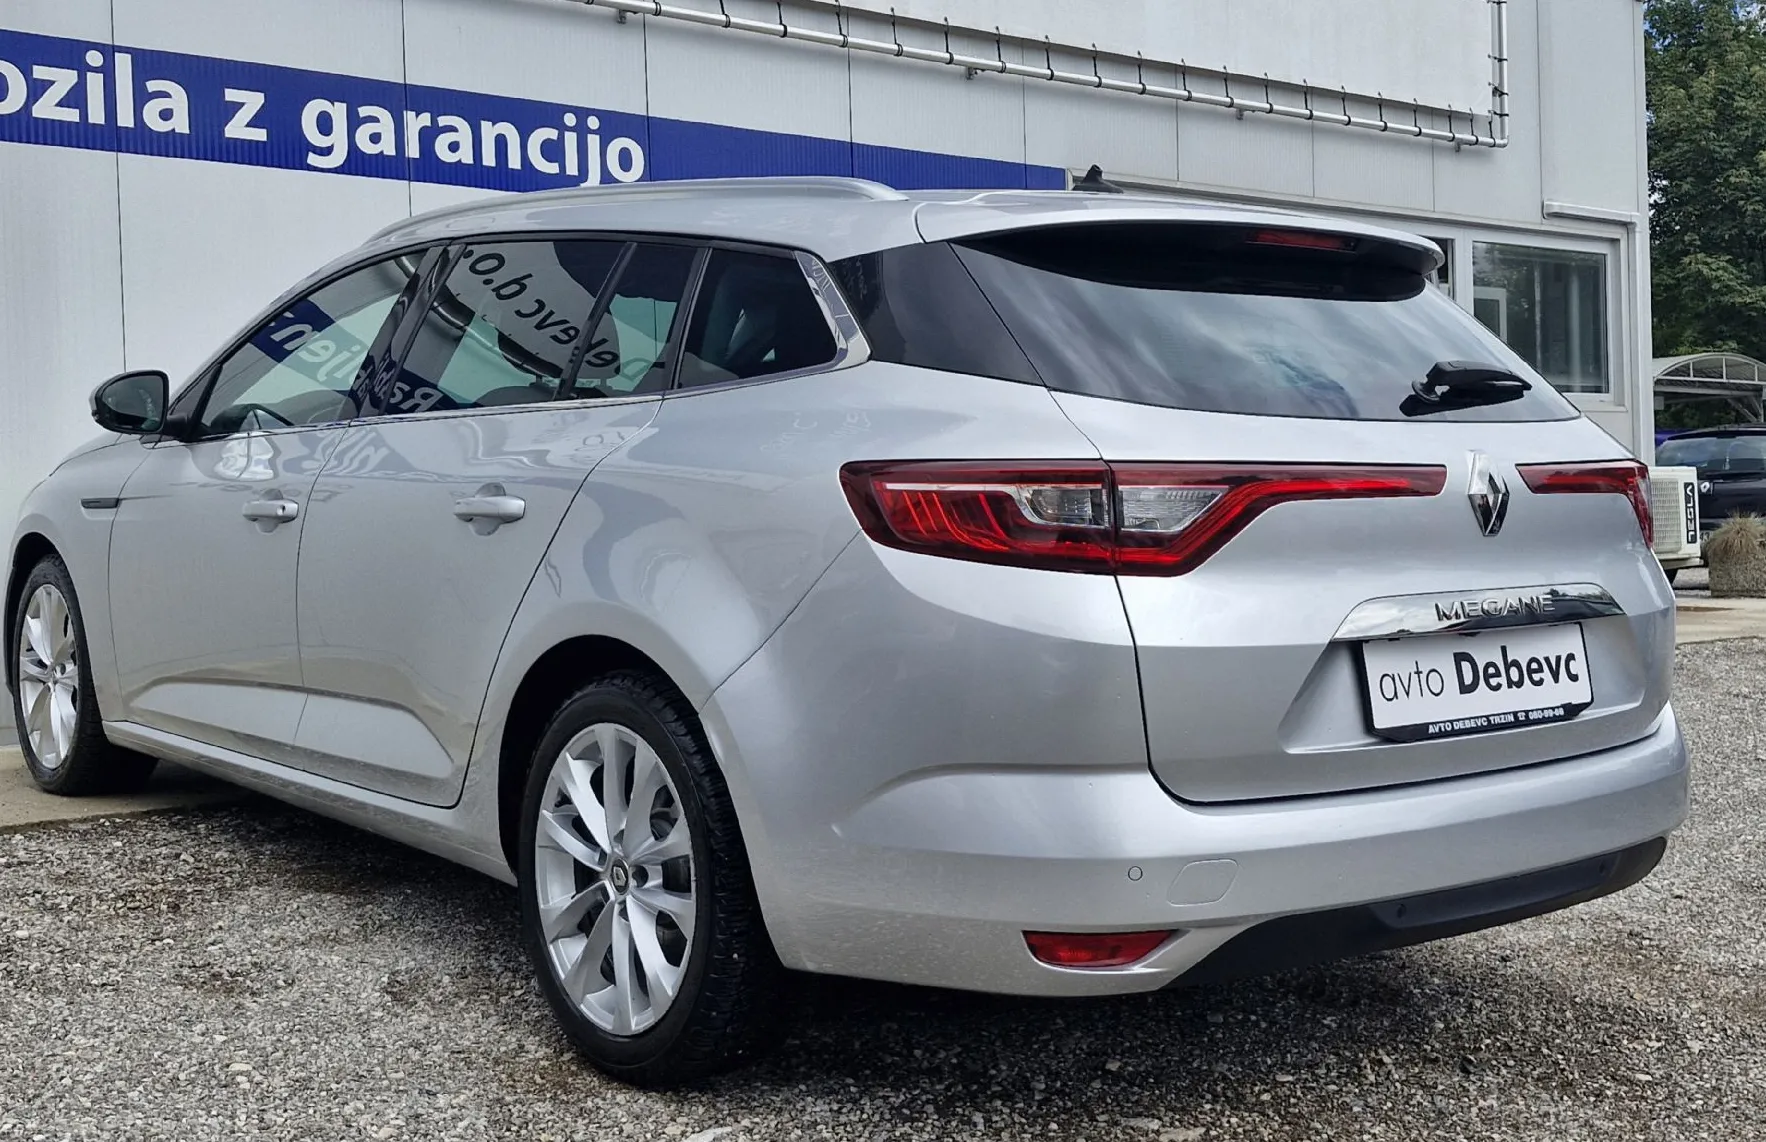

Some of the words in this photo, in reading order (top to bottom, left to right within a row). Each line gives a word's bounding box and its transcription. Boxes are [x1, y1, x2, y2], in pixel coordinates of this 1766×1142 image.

[224, 87, 268, 142] z
[301, 97, 645, 186] garancijo
[1685, 484, 1696, 543] TESLA
[1434, 594, 1556, 621] MEGANE
[1379, 660, 1445, 702] avto
[1453, 645, 1579, 695] Debevc
[1428, 721, 1452, 734] AVTO
[1453, 716, 1488, 730] DEBEVC
[1489, 712, 1514, 725] TRZIN
